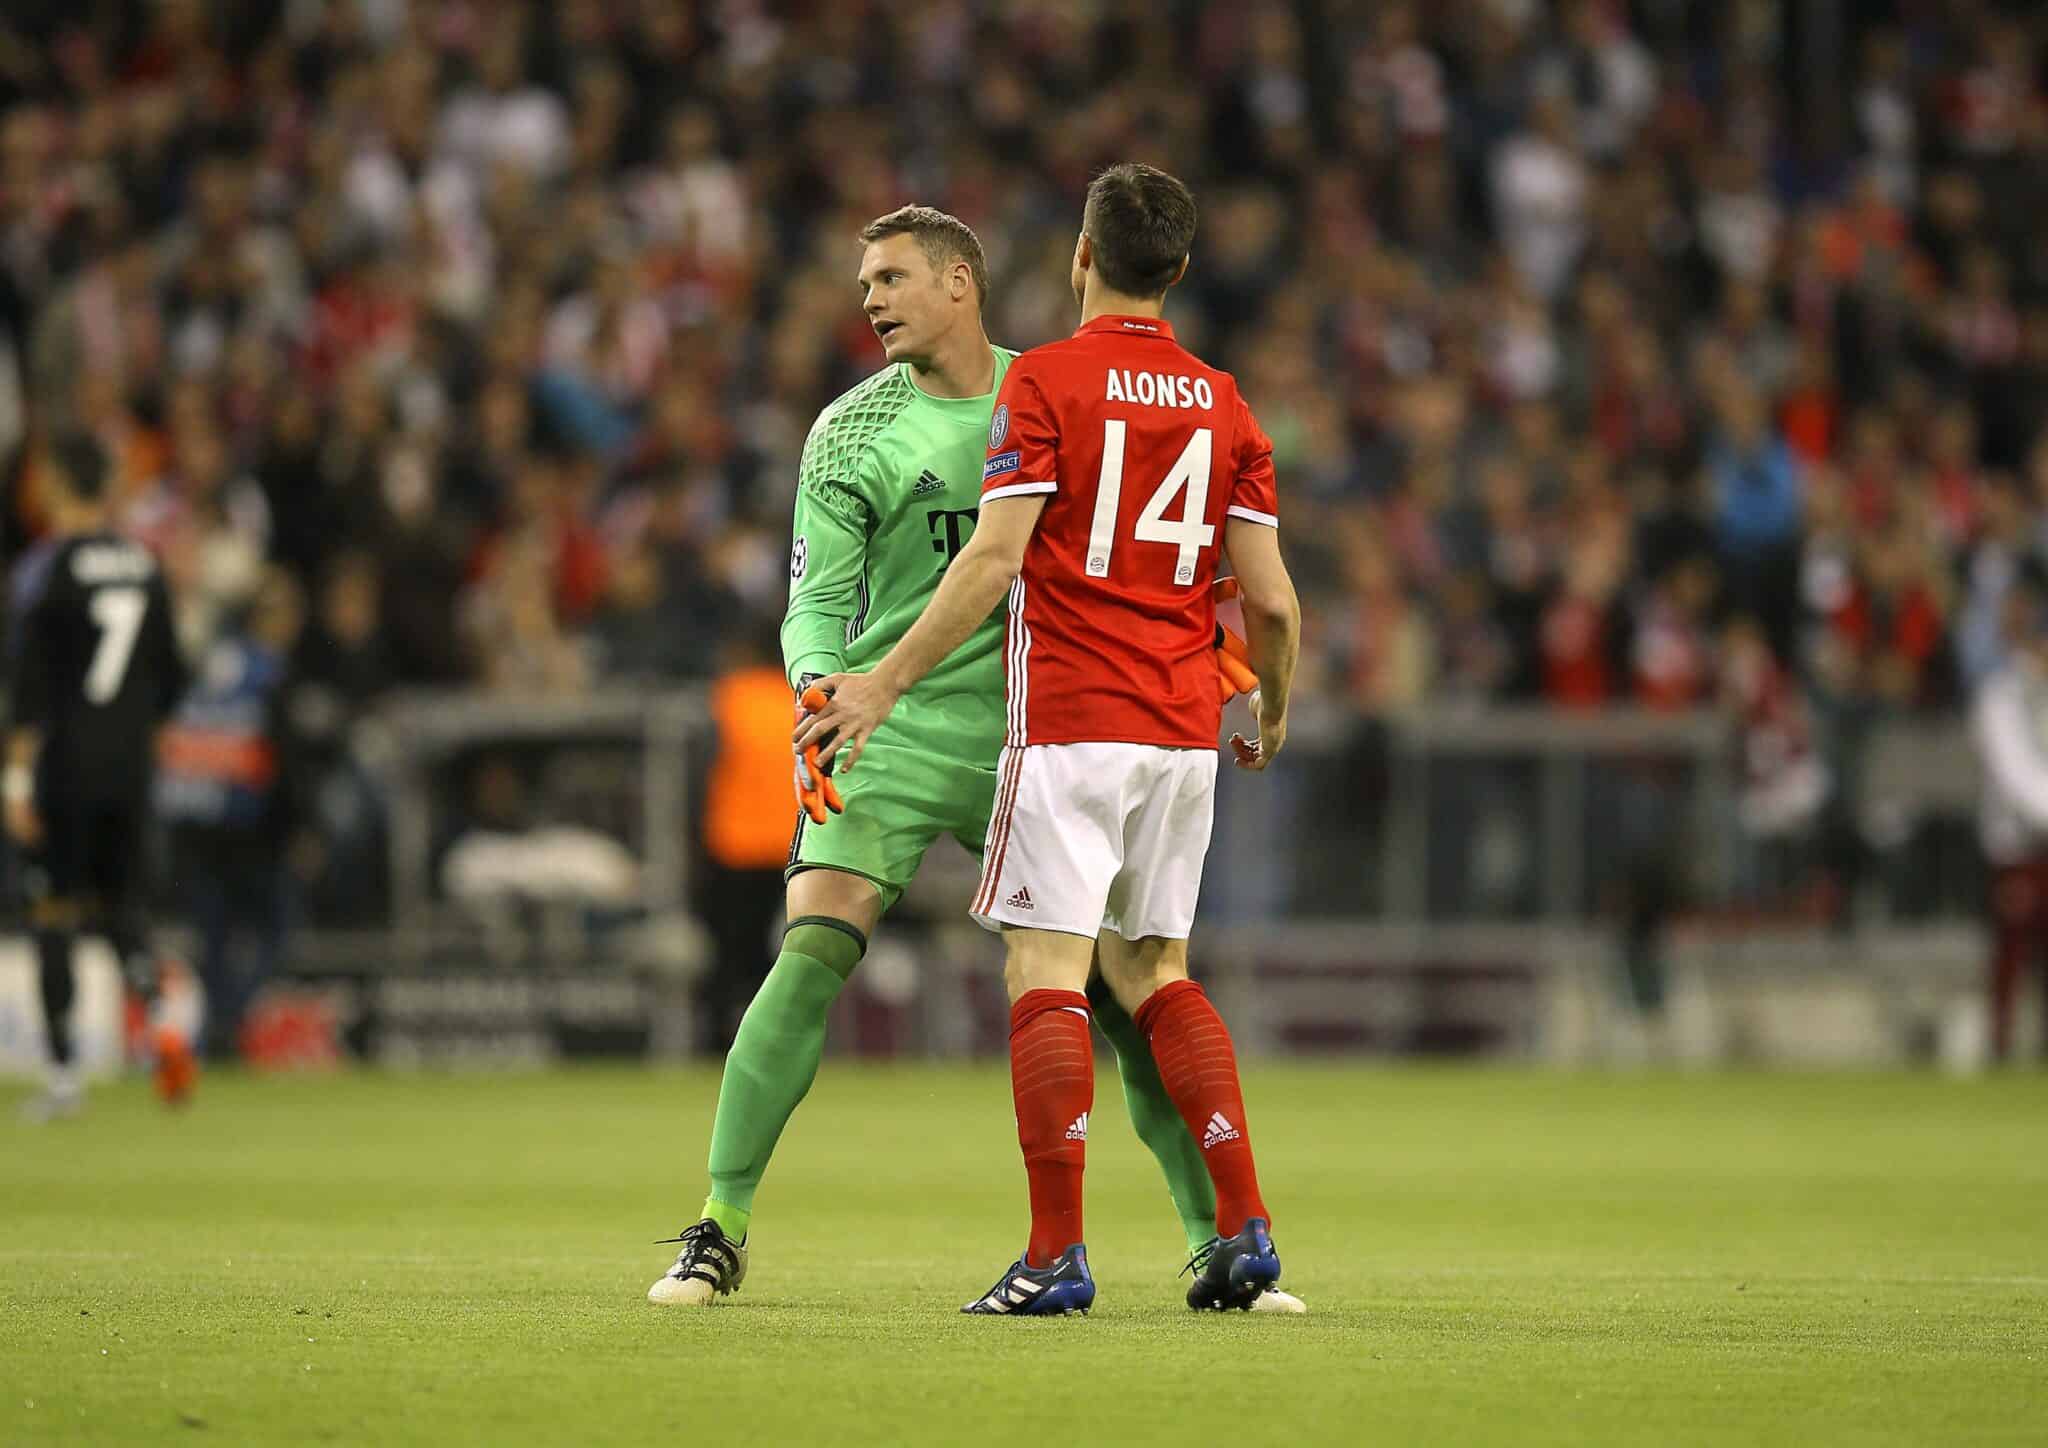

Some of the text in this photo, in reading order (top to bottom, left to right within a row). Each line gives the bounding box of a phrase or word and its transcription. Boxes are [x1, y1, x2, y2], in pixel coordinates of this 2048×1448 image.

[1106, 368, 1213, 410] ALONSO
[912, 480, 946, 496] adidas
[1085, 419, 1215, 586] 14
[83, 586, 148, 706] 7
[1006, 898, 1034, 910] adidas
[1203, 1129, 1239, 1149] adidas
